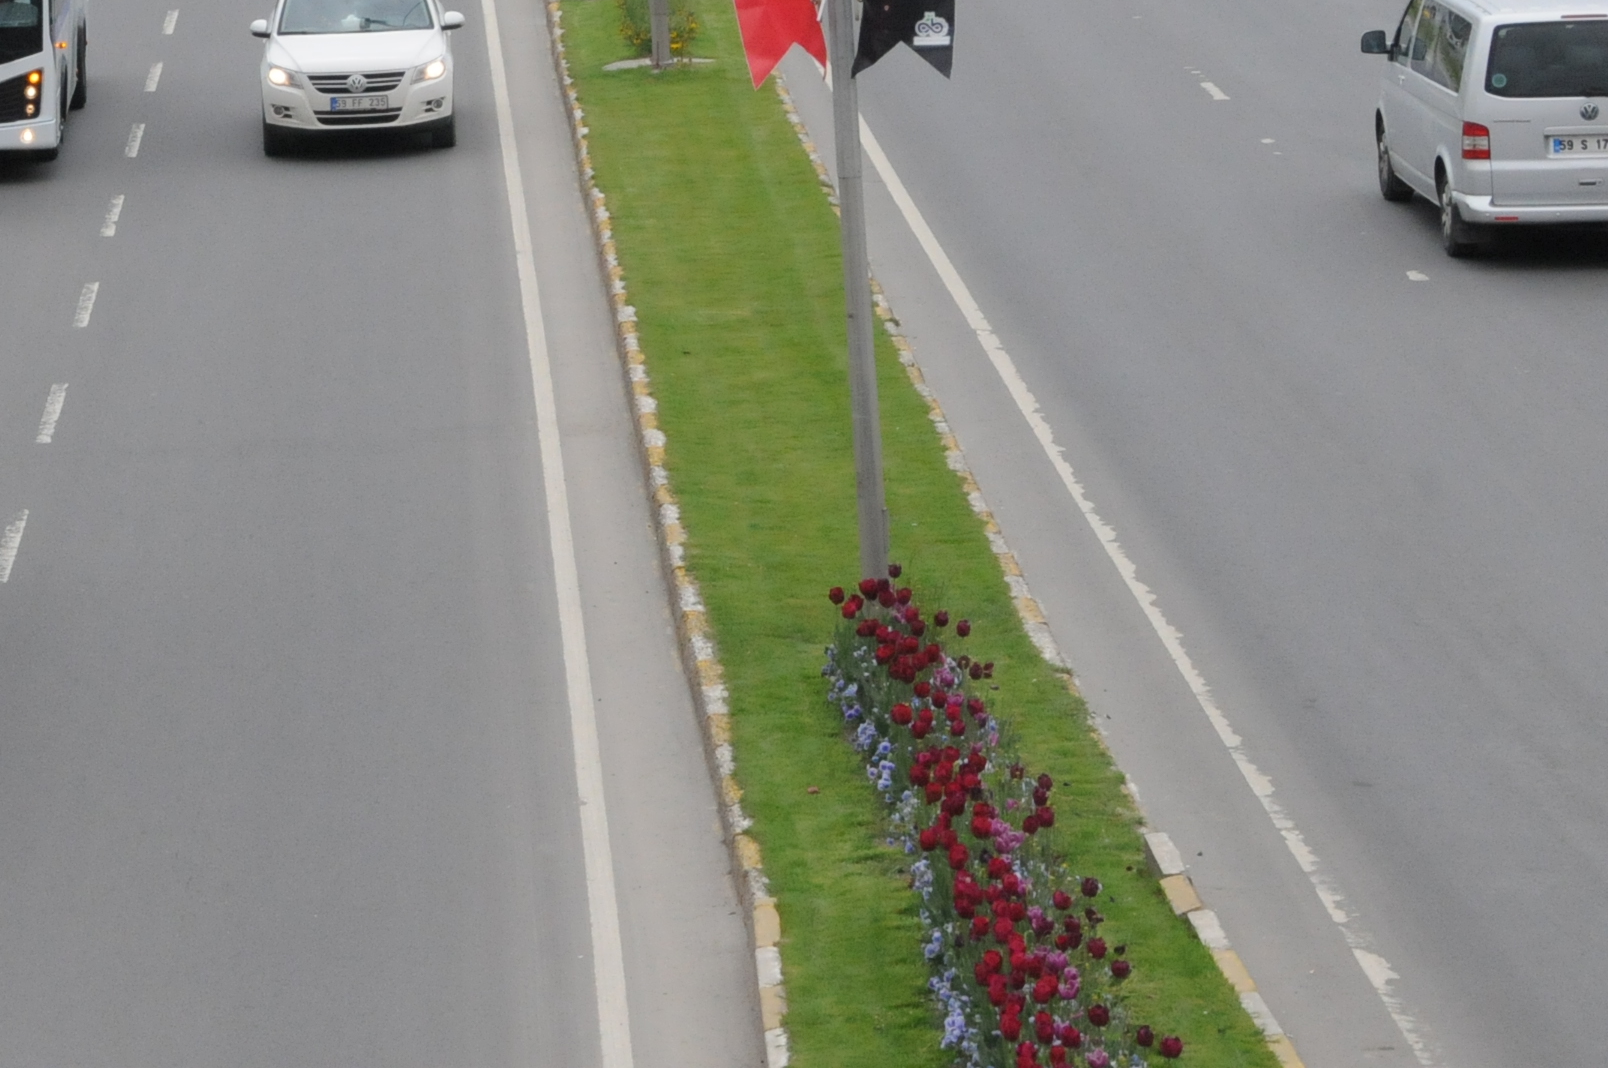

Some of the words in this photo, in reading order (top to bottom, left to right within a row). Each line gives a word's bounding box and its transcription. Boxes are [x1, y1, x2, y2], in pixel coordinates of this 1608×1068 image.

[352, 98, 364, 108] FF
[368, 96, 387, 108] 235
[1560, 139, 1574, 151] 59
[1580, 139, 1589, 151] S
